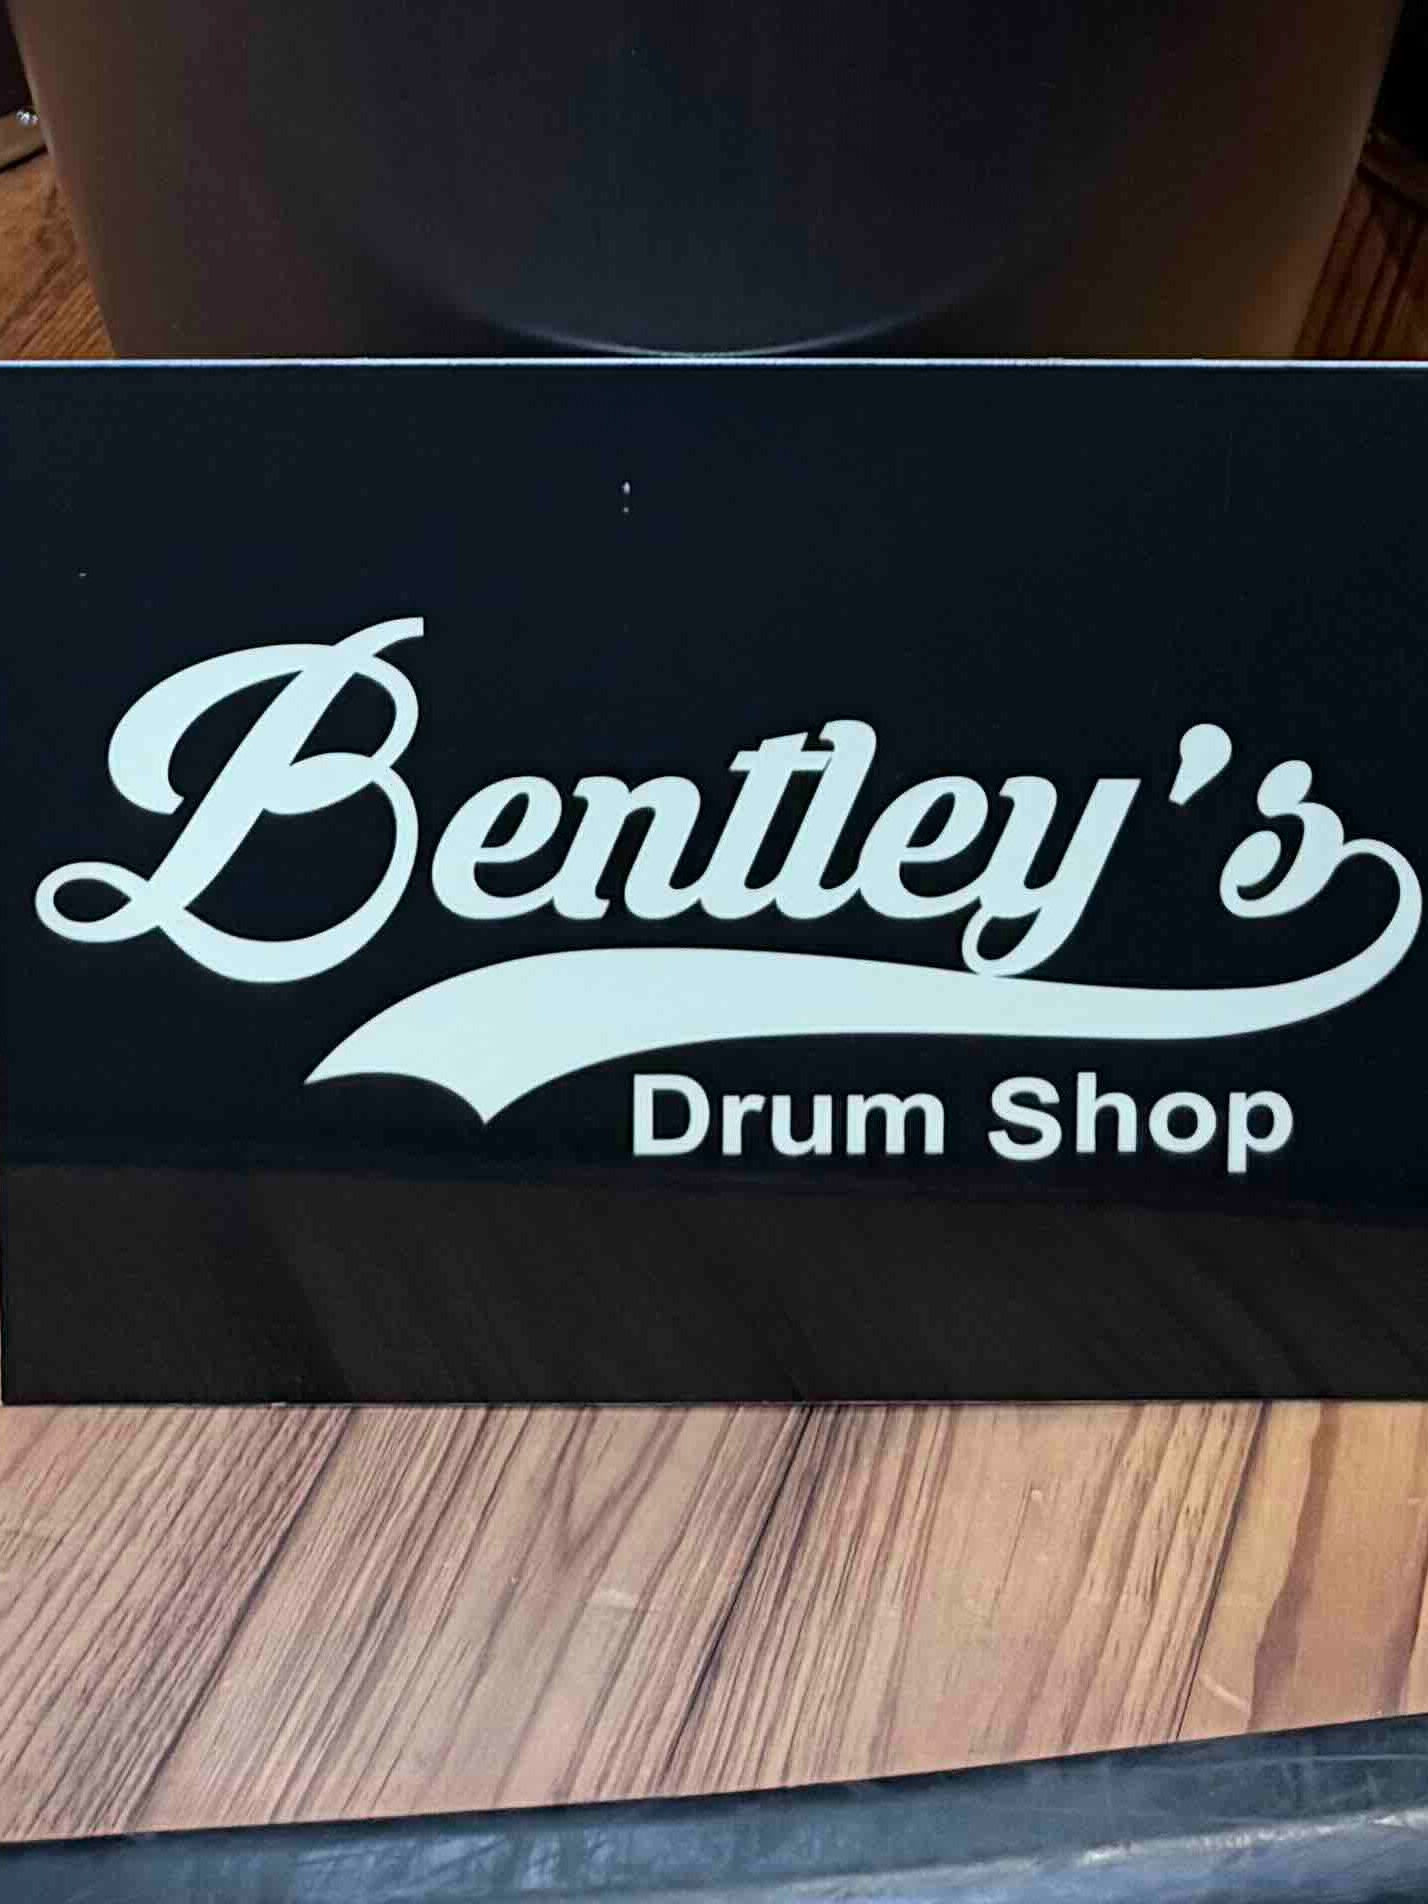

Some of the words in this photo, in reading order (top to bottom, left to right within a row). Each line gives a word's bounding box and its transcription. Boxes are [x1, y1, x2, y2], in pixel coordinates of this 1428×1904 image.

[35, 617, 1424, 984] Bentley's
[633, 1072, 947, 1158] Drum
[988, 1072, 1296, 1174] Shop
